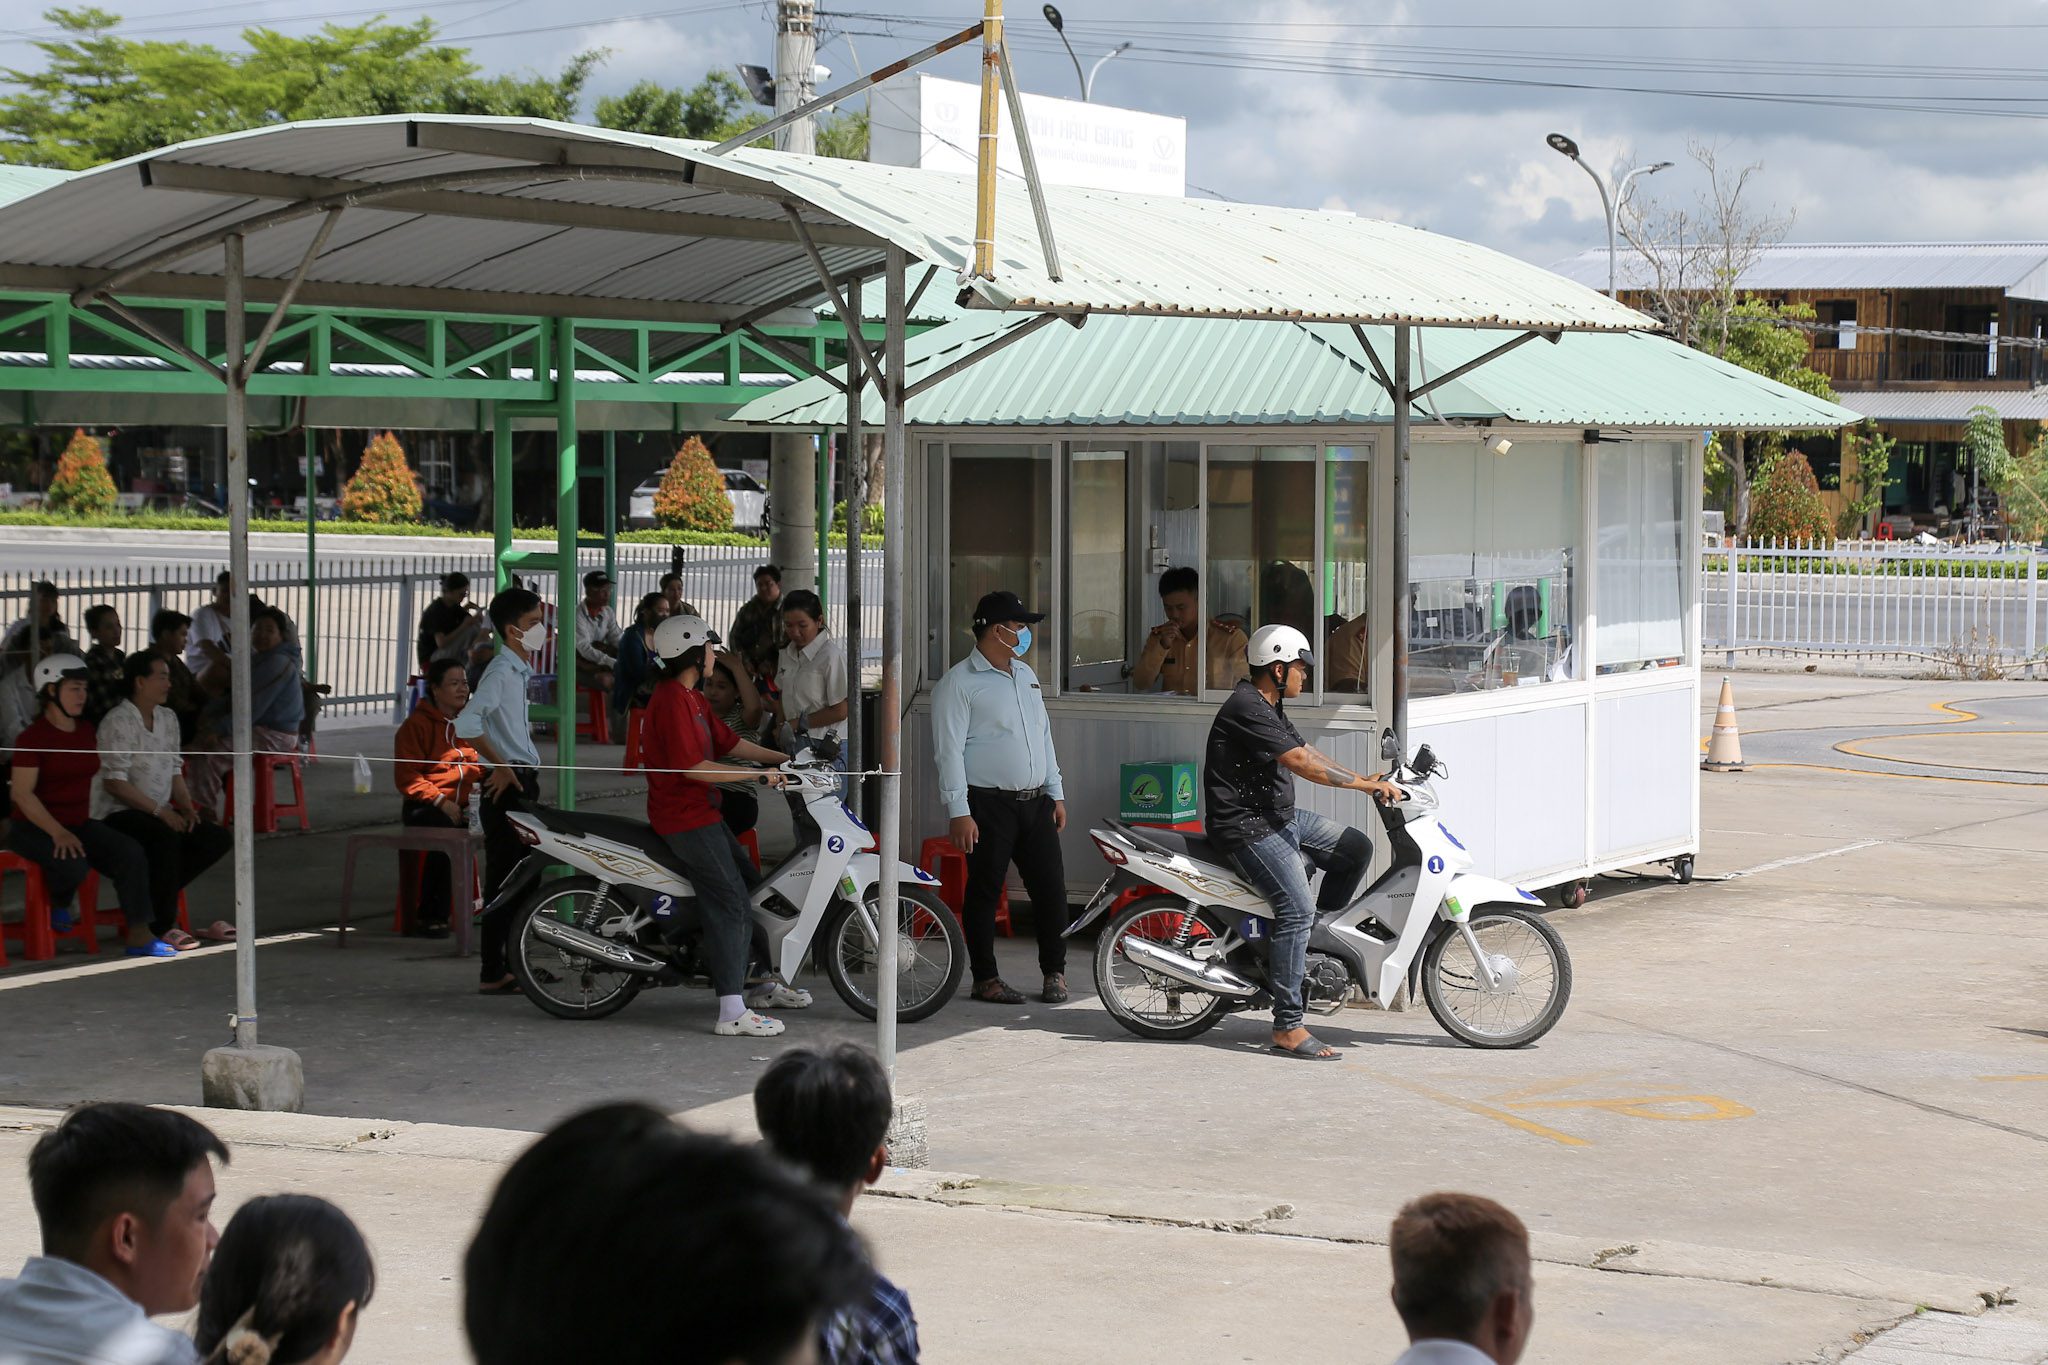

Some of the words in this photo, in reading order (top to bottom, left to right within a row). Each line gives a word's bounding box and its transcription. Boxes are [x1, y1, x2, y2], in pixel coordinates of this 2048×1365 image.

[830, 837, 841, 852] 2
[1432, 858, 1441, 873] 1
[656, 894, 672, 916] 2
[1248, 917, 1261, 938] 1
